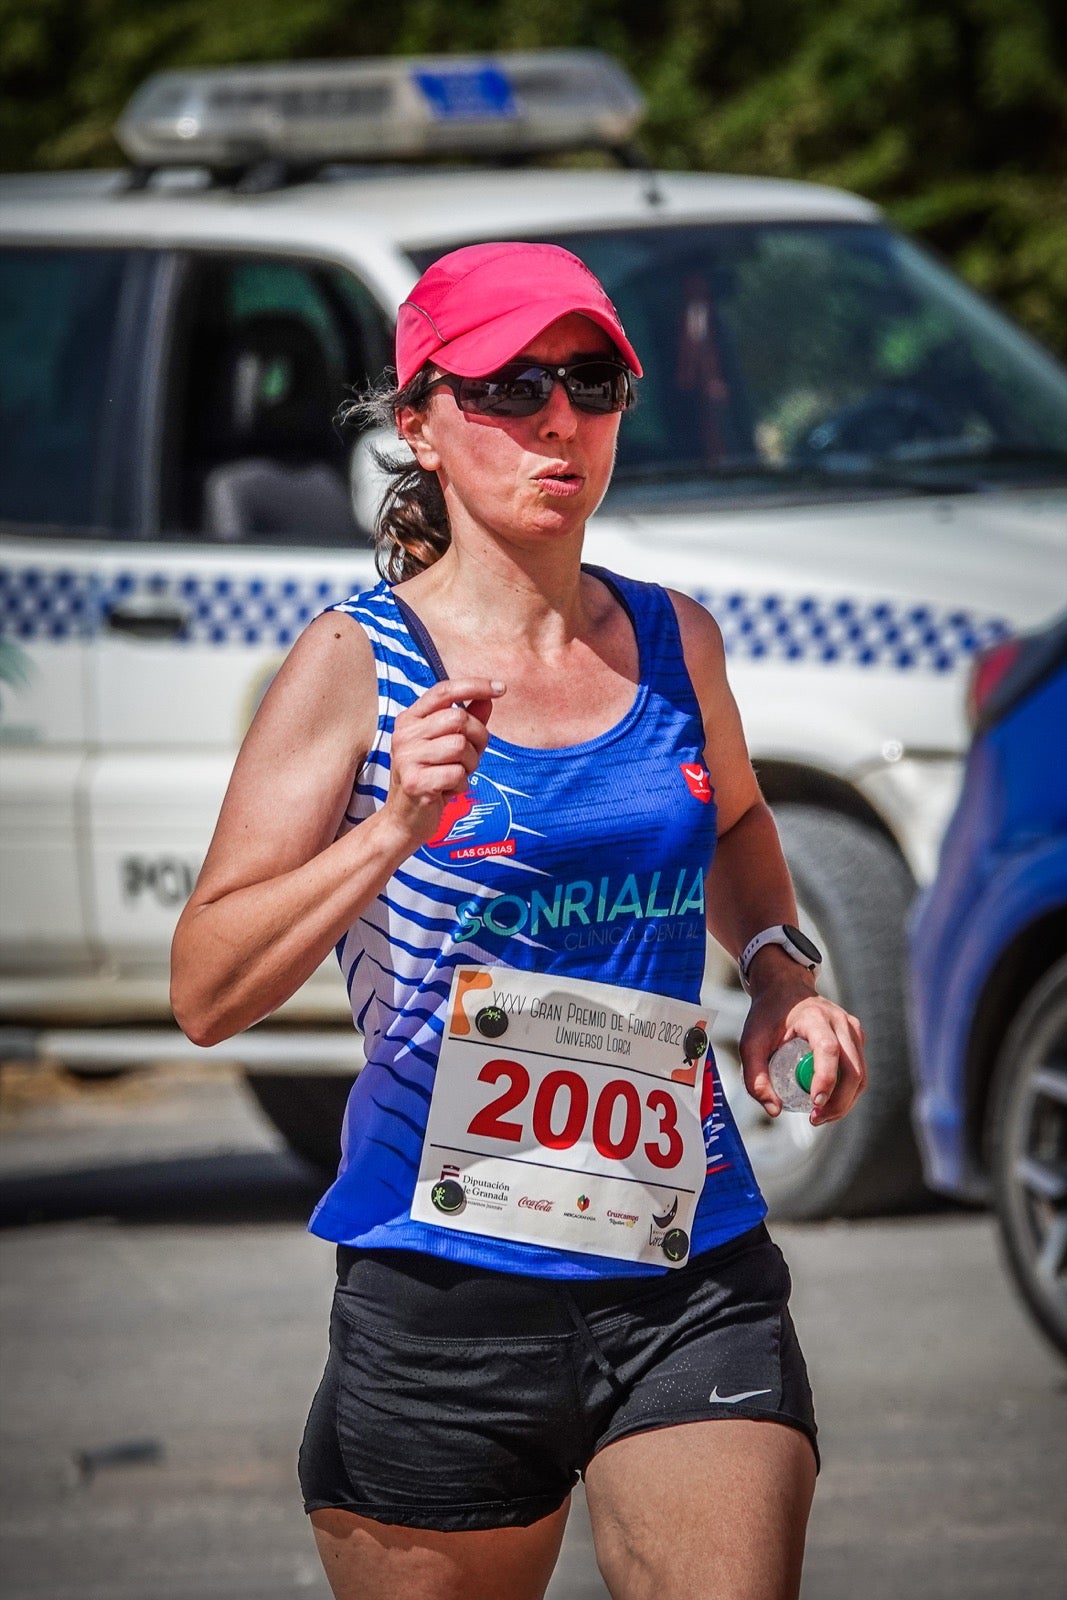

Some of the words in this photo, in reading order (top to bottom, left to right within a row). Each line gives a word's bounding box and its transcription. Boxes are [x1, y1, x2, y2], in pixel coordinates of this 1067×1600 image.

[457, 848, 476, 858] LAS
[477, 845, 513, 856] GABIAS
[453, 867, 705, 944] SONRIALIA
[564, 924, 636, 951] CLÍNICA
[643, 921, 700, 943] DENTAL
[611, 1013, 624, 1032] DE
[657, 1021, 683, 1046] 2022
[466, 1059, 684, 1169] 2003
[463, 1174, 510, 1191] Diputación
[472, 1187, 508, 1201] Granada
[606, 1209, 640, 1221] Cruzcampo
